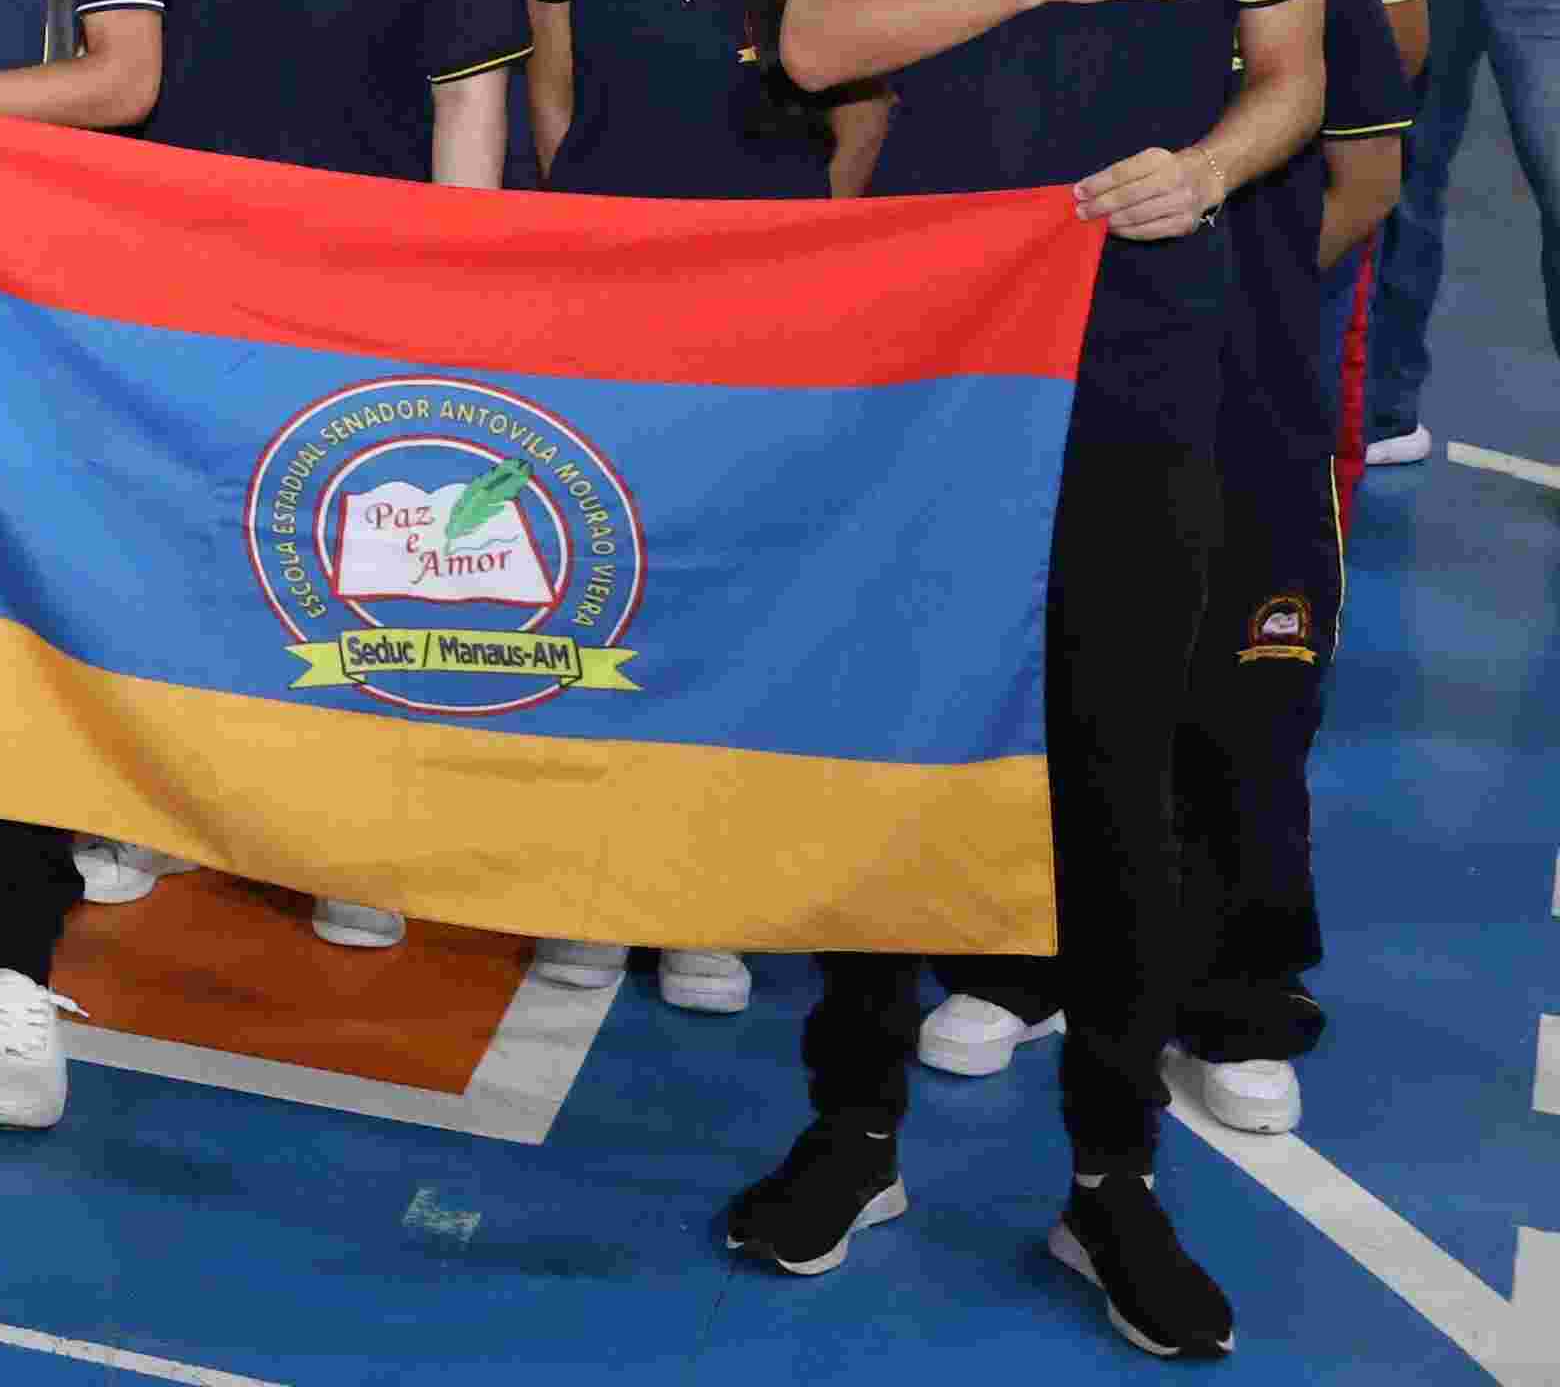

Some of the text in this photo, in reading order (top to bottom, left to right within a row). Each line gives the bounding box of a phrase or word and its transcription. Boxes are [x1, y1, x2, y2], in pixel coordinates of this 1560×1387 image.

[319, 398, 431, 447] SENADOR
[439, 399, 561, 466] ANTOVILA
[273, 441, 328, 536] ESTADUAL
[364, 502, 435, 530] Paz
[405, 532, 420, 554] e
[410, 547, 513, 585] Amor
[276, 540, 327, 619] ESCOLA
[572, 563, 617, 627] VIEIRA
[347, 634, 416, 666] Seduc
[439, 637, 572, 670] Manaus-AM
